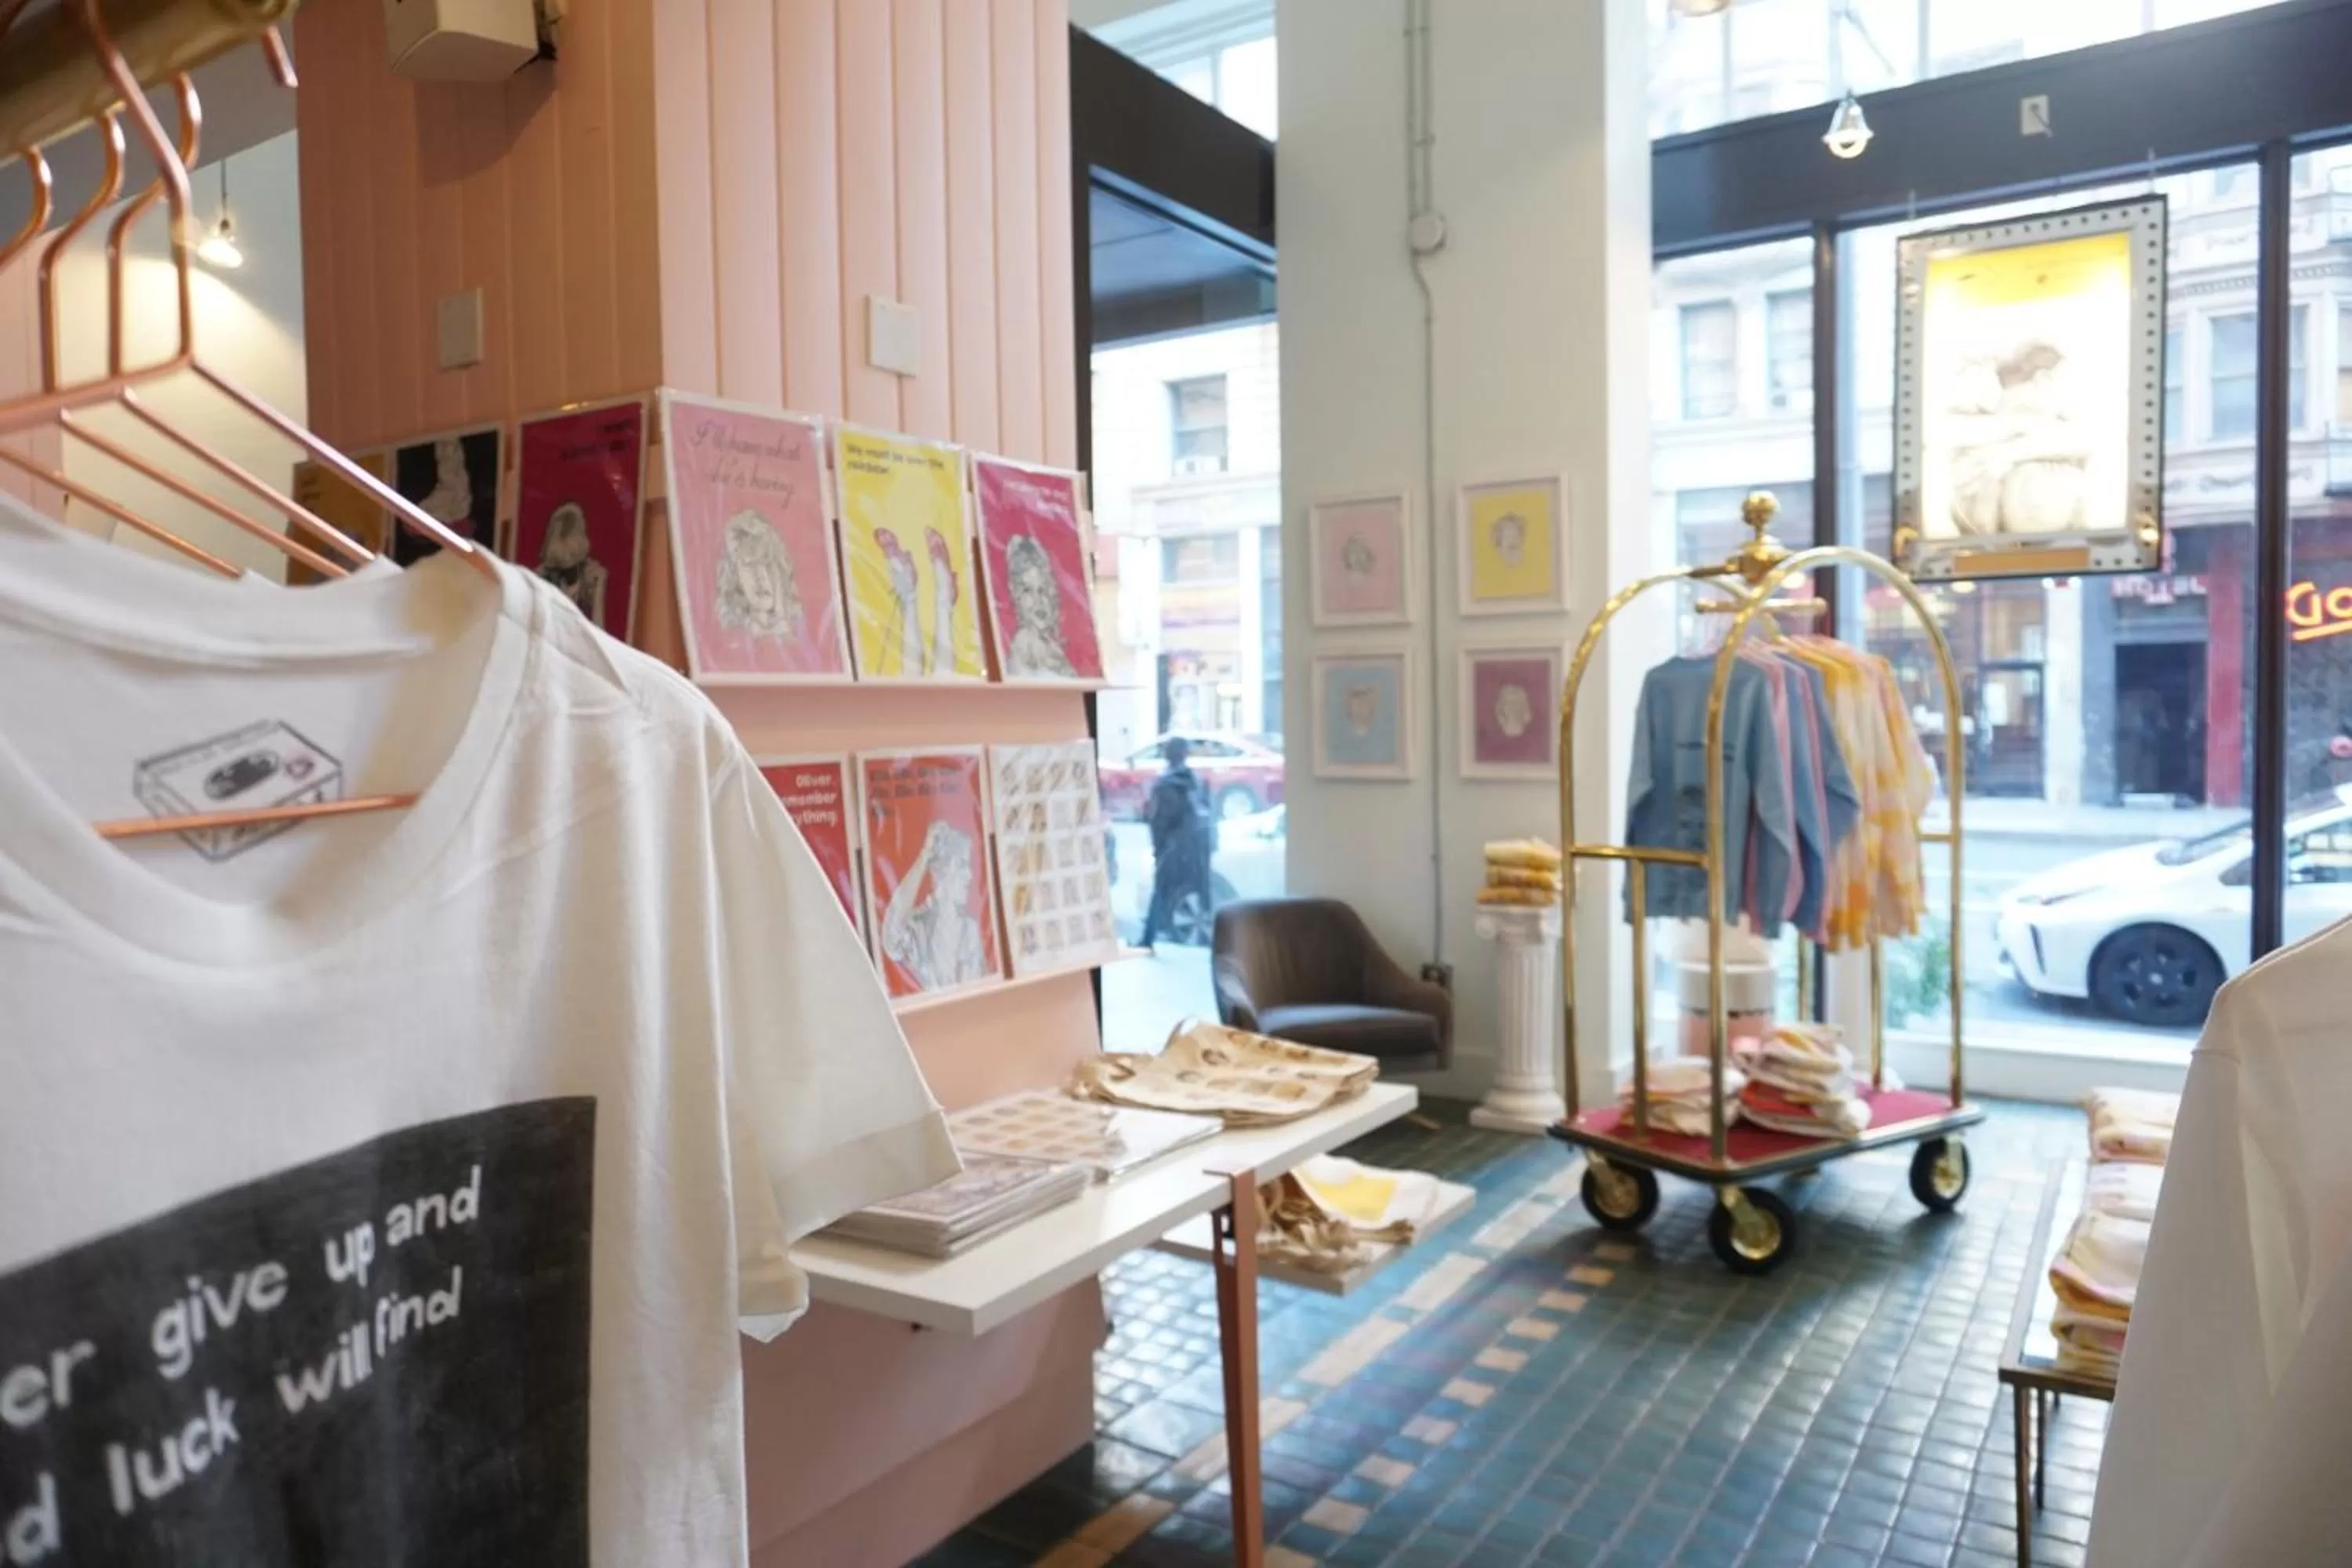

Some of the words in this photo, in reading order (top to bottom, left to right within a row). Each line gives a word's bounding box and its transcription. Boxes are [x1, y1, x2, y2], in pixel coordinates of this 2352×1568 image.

[152, 1259, 289, 1380] give
[325, 1220, 376, 1288] up
[385, 1163, 483, 1247] and
[104, 1386, 241, 1518] luck
[274, 1320, 372, 1414] will
[375, 1265, 463, 1360] find
